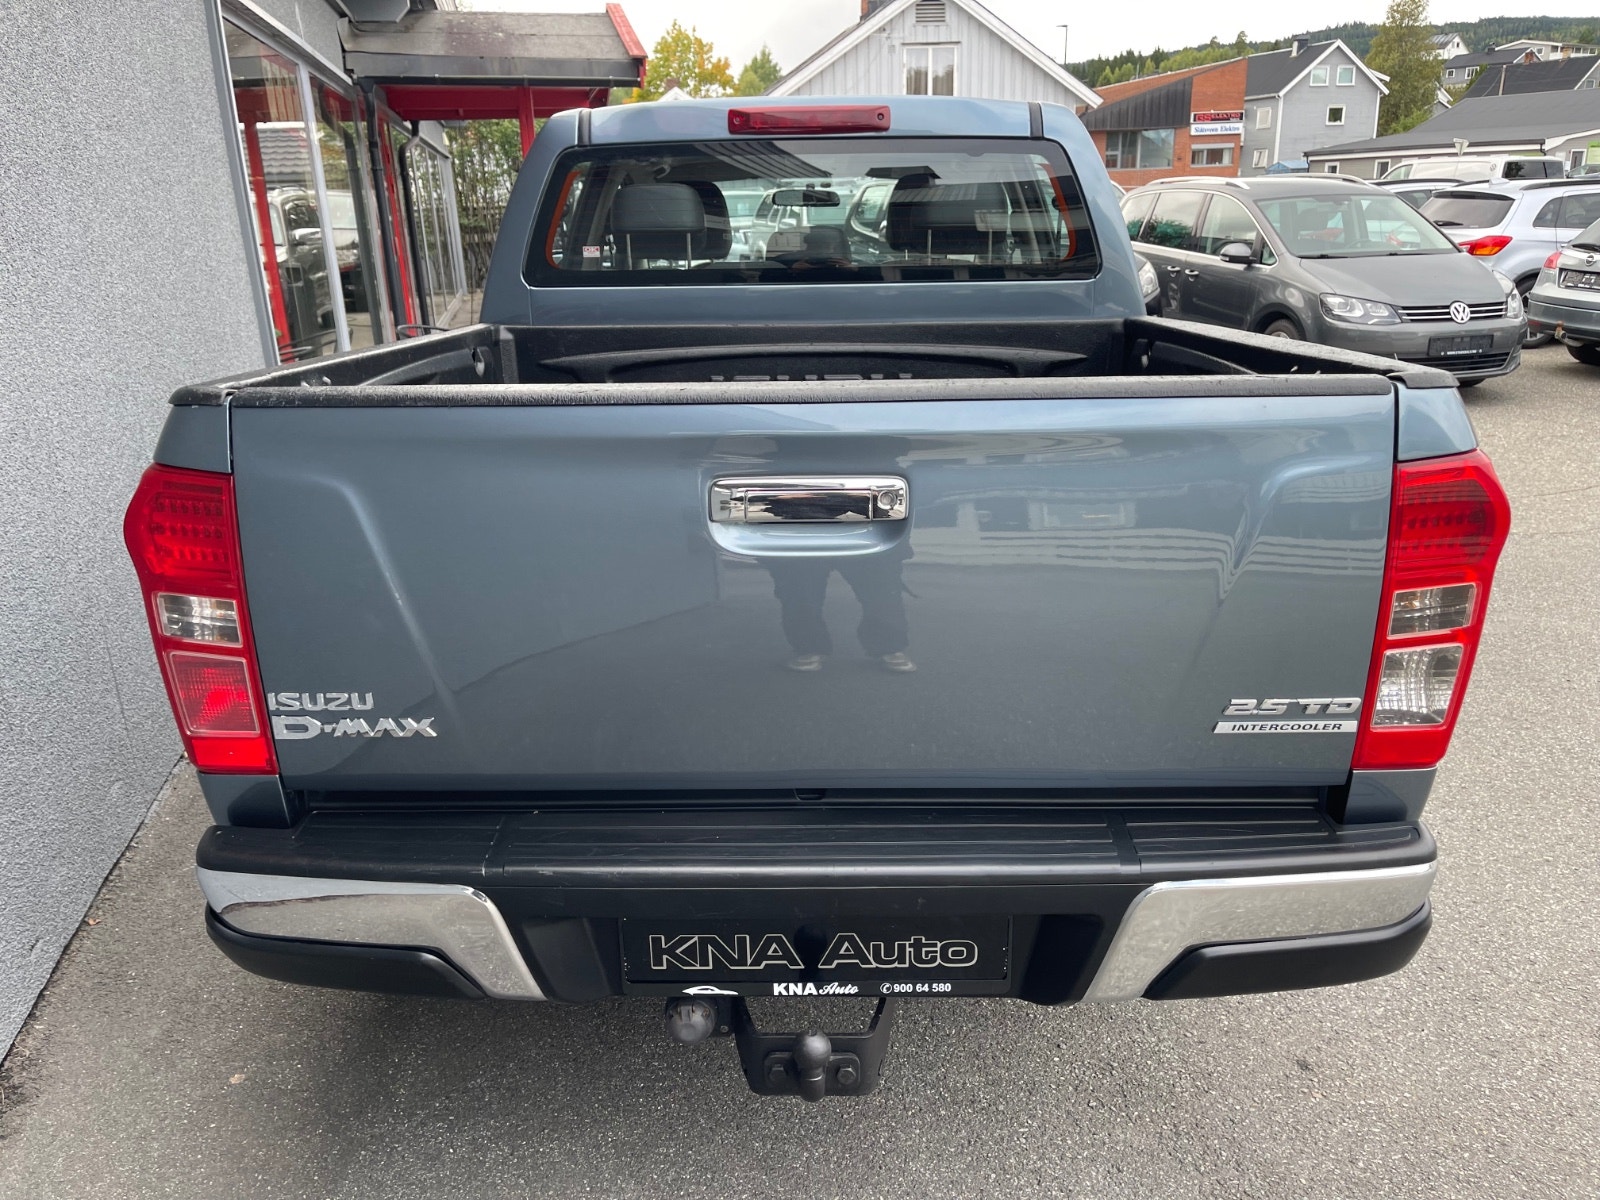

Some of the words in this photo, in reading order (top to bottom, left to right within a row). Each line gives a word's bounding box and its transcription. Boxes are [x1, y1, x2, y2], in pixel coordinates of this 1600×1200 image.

[268, 692, 374, 711] ISUZU
[1297, 697, 1361, 714] TD
[272, 715, 437, 739] D-MAX
[1231, 723, 1342, 731] INTERCOOLER
[649, 934, 804, 970] KNA
[818, 933, 979, 969] Auto
[773, 983, 818, 996] KNA
[818, 982, 859, 995] Auto
[893, 983, 913, 992] 900
[916, 983, 929, 992] 64
[932, 983, 951, 992] 580
